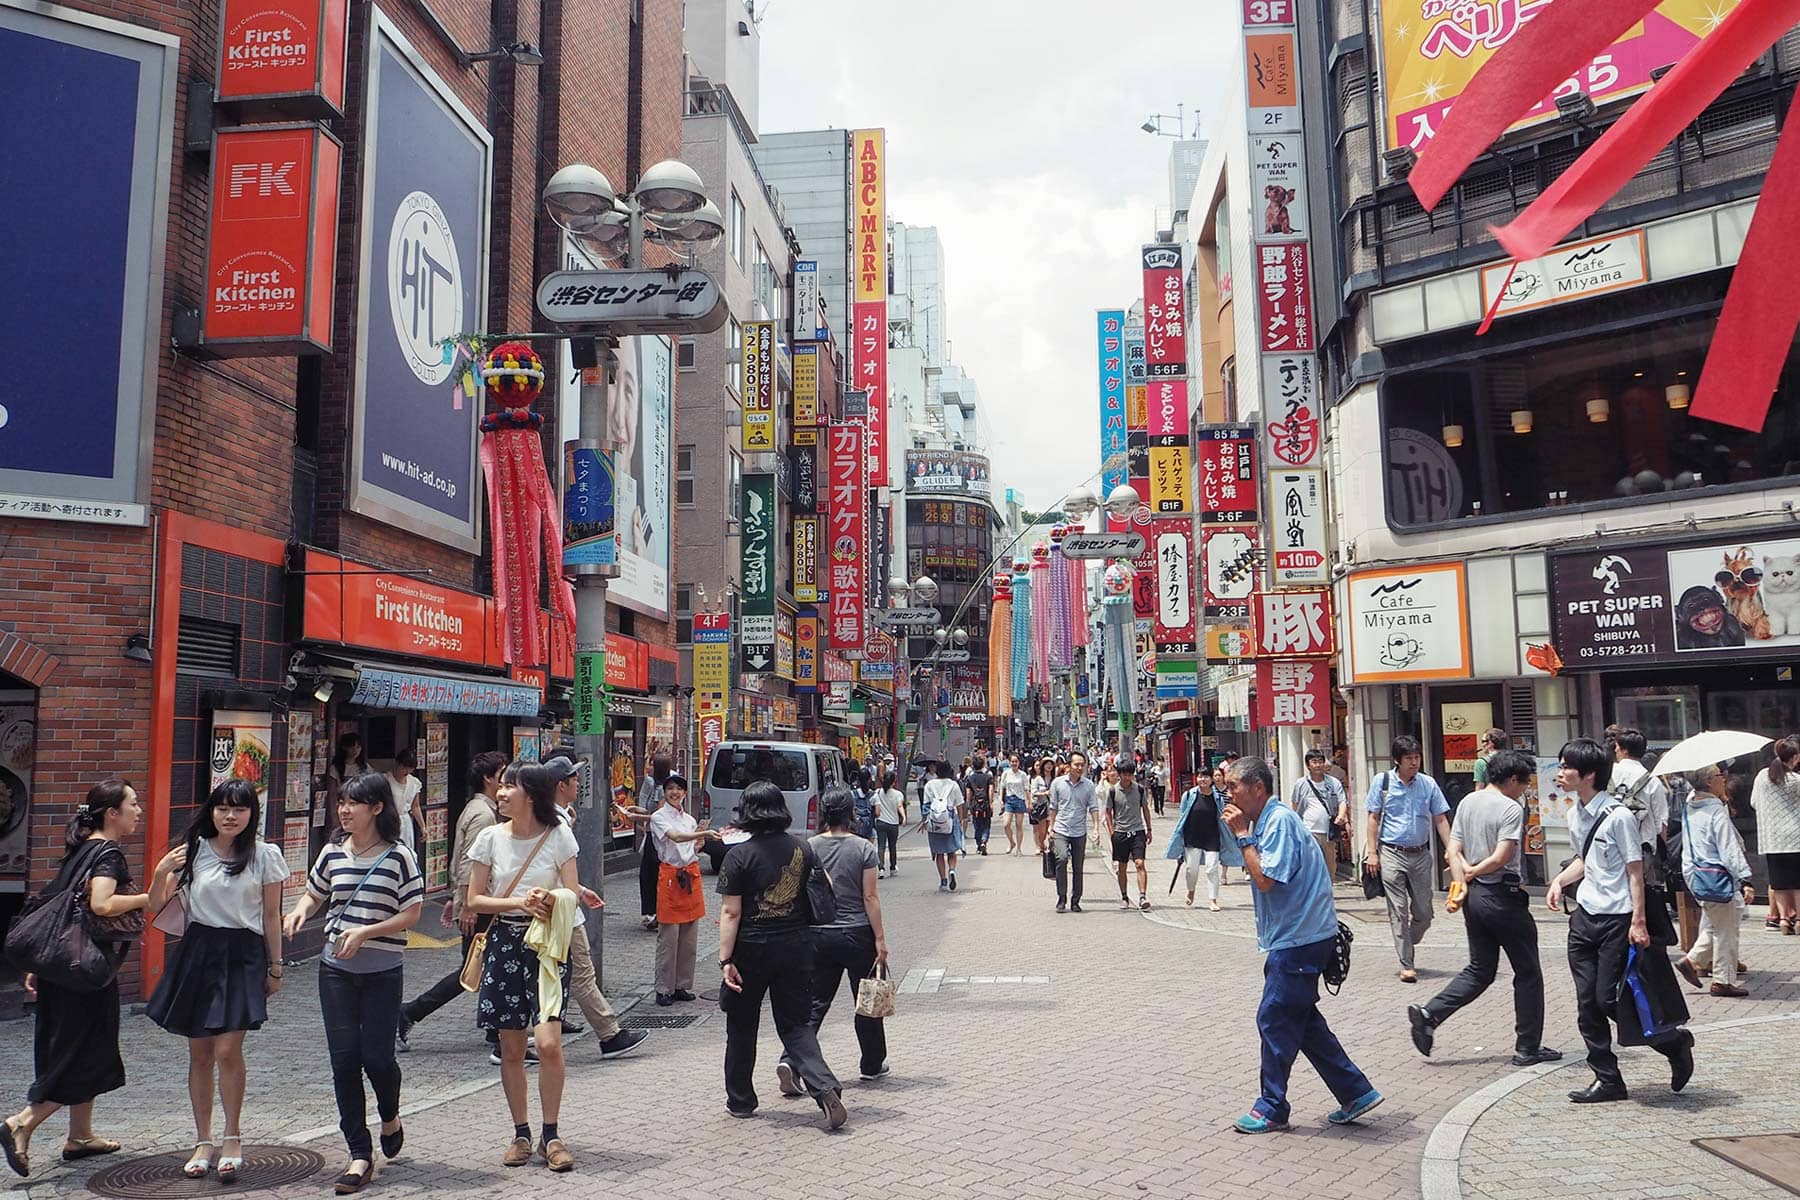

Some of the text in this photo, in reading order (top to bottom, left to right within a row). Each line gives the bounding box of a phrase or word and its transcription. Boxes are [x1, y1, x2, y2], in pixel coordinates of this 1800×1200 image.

[1250, 0, 1287, 22] 3F
[245, 27, 292, 43] First
[229, 43, 306, 59] Kitchen
[1264, 112, 1283, 125] 2F
[1256, 161, 1298, 170] PET SUPER
[1268, 168, 1287, 176] WAN
[230, 162, 297, 198] FK
[1573, 257, 1605, 275] Cafe
[232, 269, 280, 285] First
[1557, 268, 1623, 292] Miyama
[215, 286, 295, 302] Kitchen
[547, 281, 708, 307] 渋谷センター街
[1262, 246, 1291, 350] 野郎ラーメン
[215, 301, 295, 313] ファースト キッチン
[1164, 275, 1183, 337] お好み焼
[1147, 303, 1166, 360] もんじゃ
[759, 326, 771, 409] 全身もみほぐし
[1161, 436, 1175, 446] 4F
[381, 450, 458, 498] www.hit-ad.co.jp
[833, 427, 859, 533] カラオケ
[1172, 448, 1184, 498] スパゲッティ
[1219, 442, 1237, 499] お好み焼
[577, 458, 591, 517] 七夕まつり
[1202, 458, 1220, 510] もんじゃ
[1161, 501, 1180, 511] B1F
[1066, 538, 1141, 550] 渋谷センター街
[375, 577, 387, 591] City
[817, 592, 829, 601] 2F
[833, 565, 859, 643] 歌広場
[1379, 593, 1415, 608] Cafe
[1568, 594, 1664, 616] PET SUPER
[376, 593, 463, 635] First Kitchen
[702, 615, 719, 627] 4F
[1262, 594, 1326, 653] 豚
[1363, 612, 1433, 629] Miyama
[1595, 611, 1635, 628] WAN
[1593, 630, 1641, 641] SHIBUYA
[746, 646, 770, 655] B1F
[1580, 643, 1657, 658] 03-5728-2211
[798, 646, 813, 678] 松屋
[579, 655, 593, 733] 客引きは犯罪です
[1271, 662, 1317, 724] 野郎
